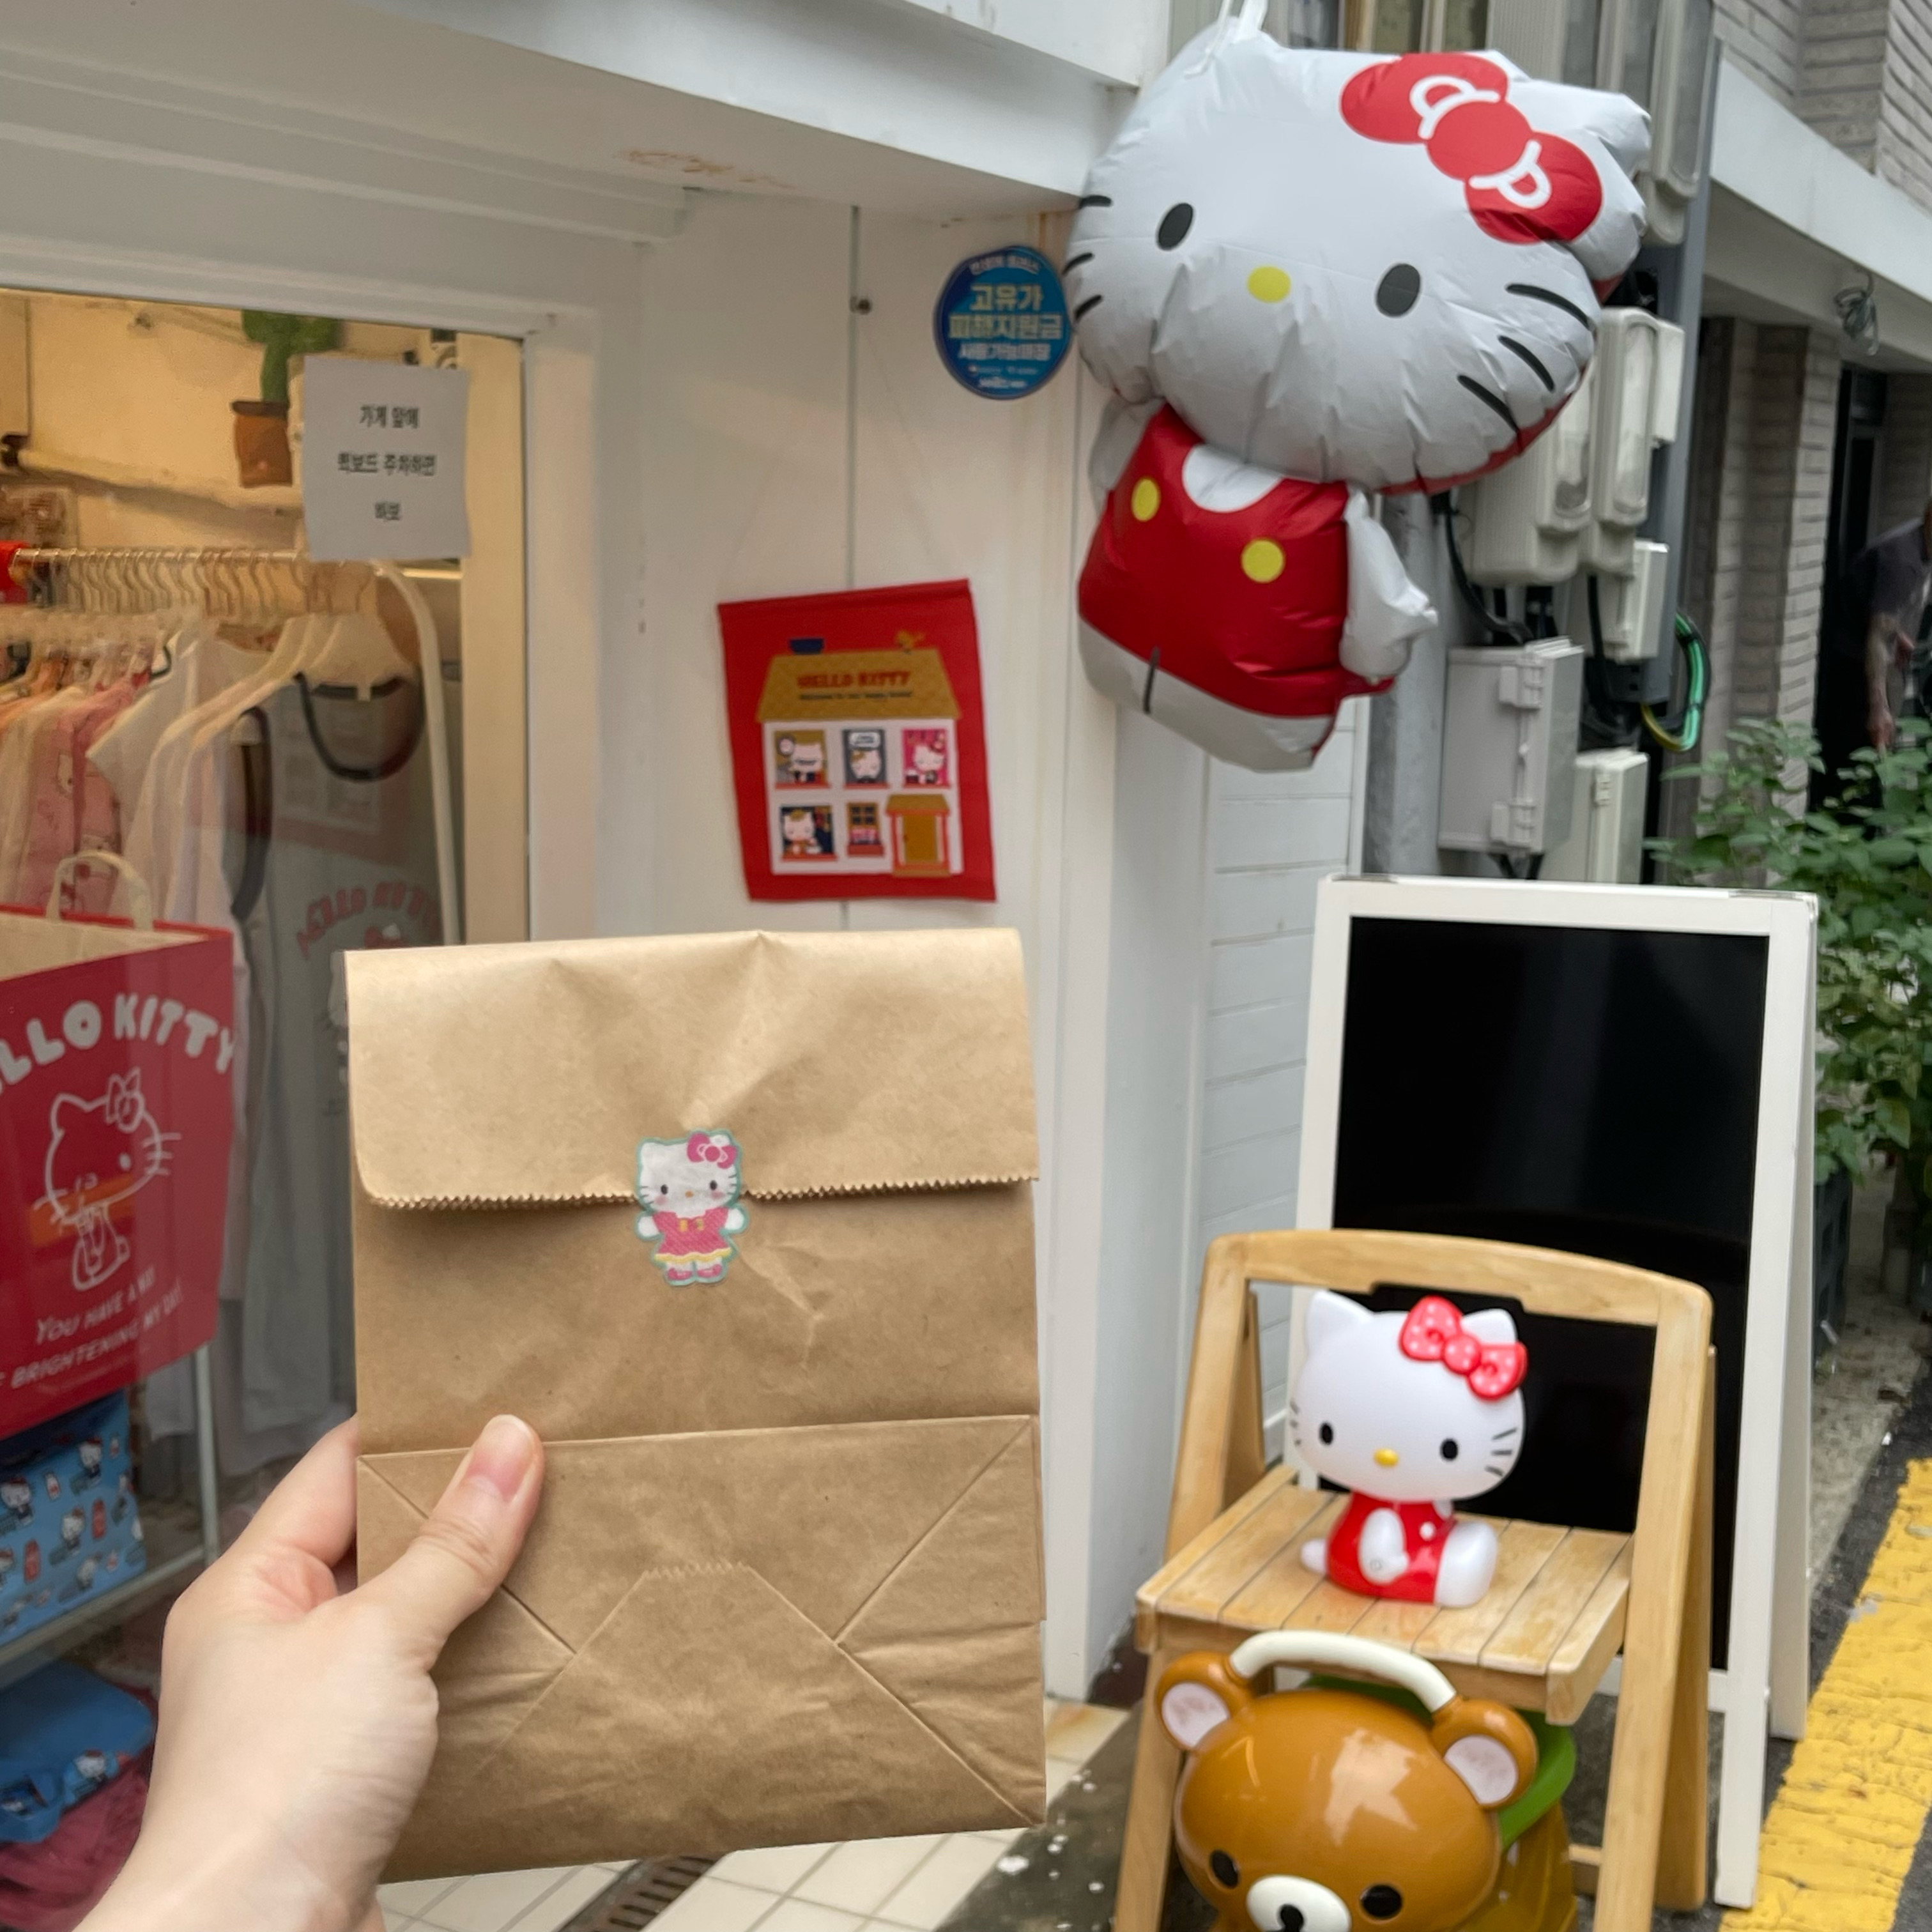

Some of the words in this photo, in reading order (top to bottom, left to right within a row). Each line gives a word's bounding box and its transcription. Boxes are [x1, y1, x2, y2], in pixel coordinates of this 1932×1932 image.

[969, 284, 1044, 311] 고유가
[358, 404, 387, 428] 가게
[797, 673, 853, 689] HELLO
[0, 999, 102, 1095] LLO
[114, 993, 234, 1075] KITTY
